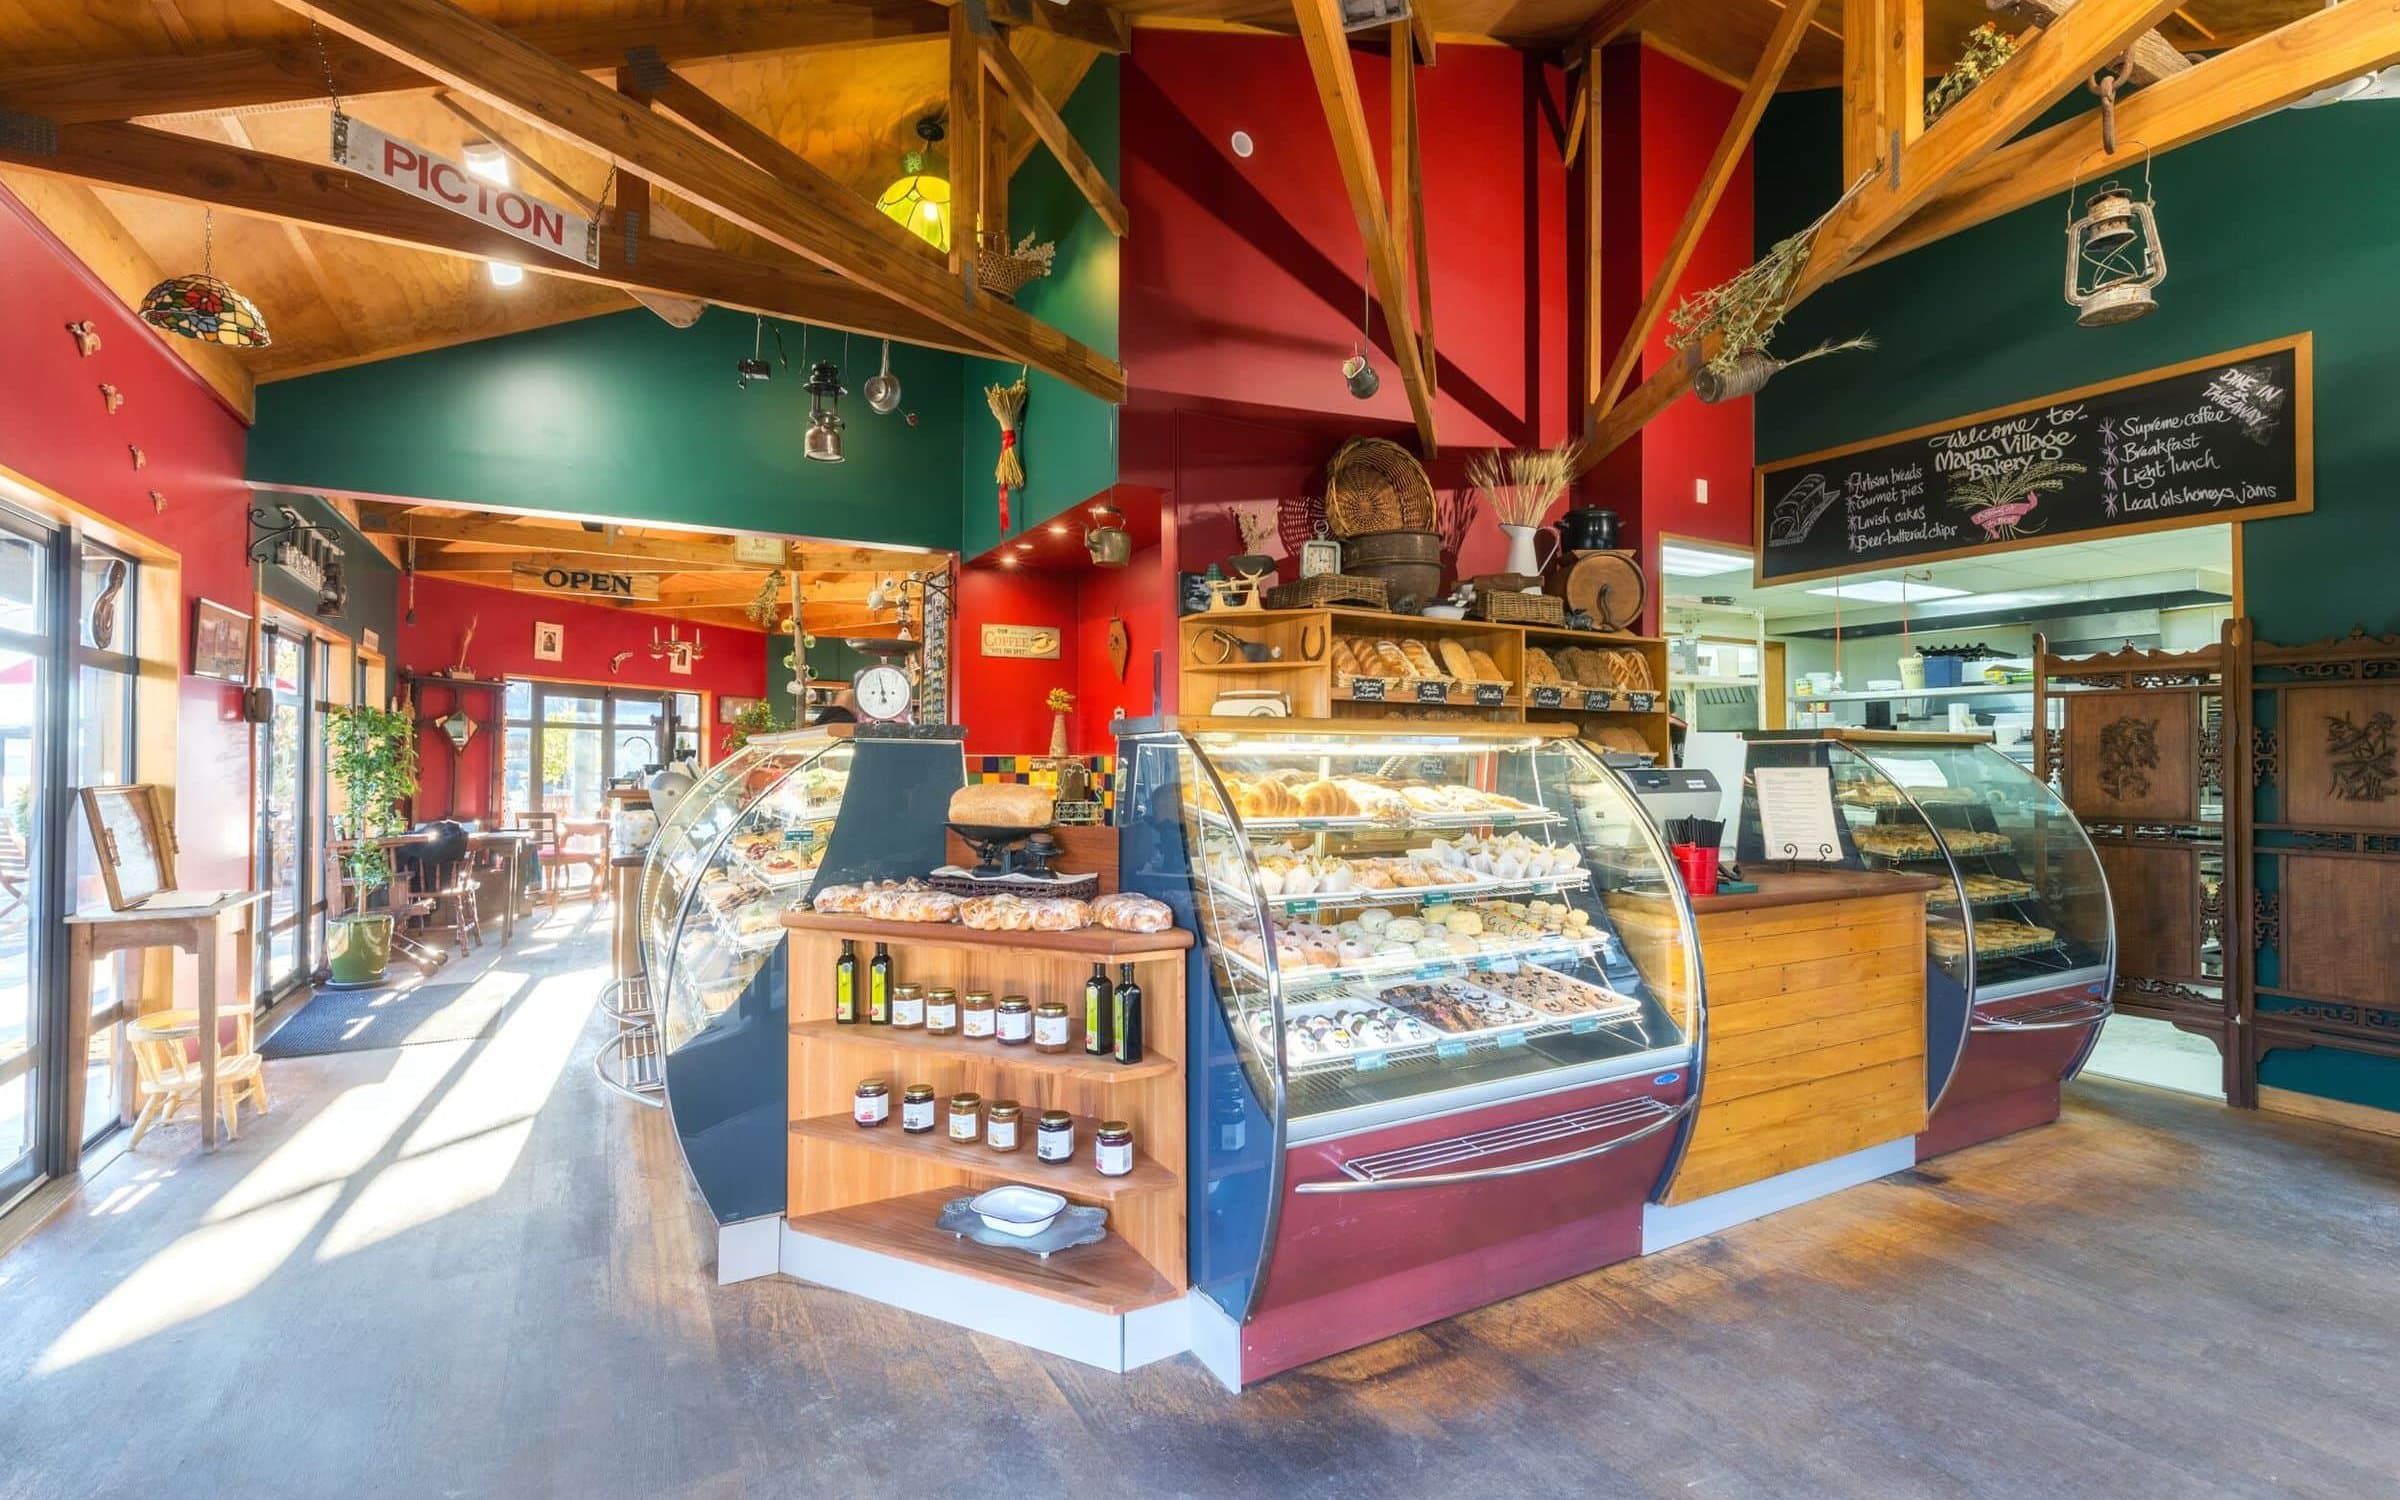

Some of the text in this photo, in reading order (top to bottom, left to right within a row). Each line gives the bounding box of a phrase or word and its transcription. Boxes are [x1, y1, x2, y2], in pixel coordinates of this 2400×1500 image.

[383, 139, 563, 246] PICTON
[2219, 368, 2284, 402] DINE IN
[2202, 382, 2268, 426] TAKEAWAY
[1928, 417, 2040, 449] Welcome
[2119, 405, 2232, 441] Supreme coffee
[1934, 428, 2078, 474] Mapua Village
[2120, 432, 2204, 463] Breakfast
[1890, 462, 1923, 484] breads
[1968, 454, 2035, 482] Bakery
[2122, 448, 2221, 489] Light lunch
[1900, 482, 1925, 505] pies
[2122, 491, 2160, 512] Local
[2236, 481, 2277, 504] jams
[1857, 505, 1926, 530] Lavish cakes
[1928, 521, 1959, 540] chips
[543, 569, 633, 594] OPEN
